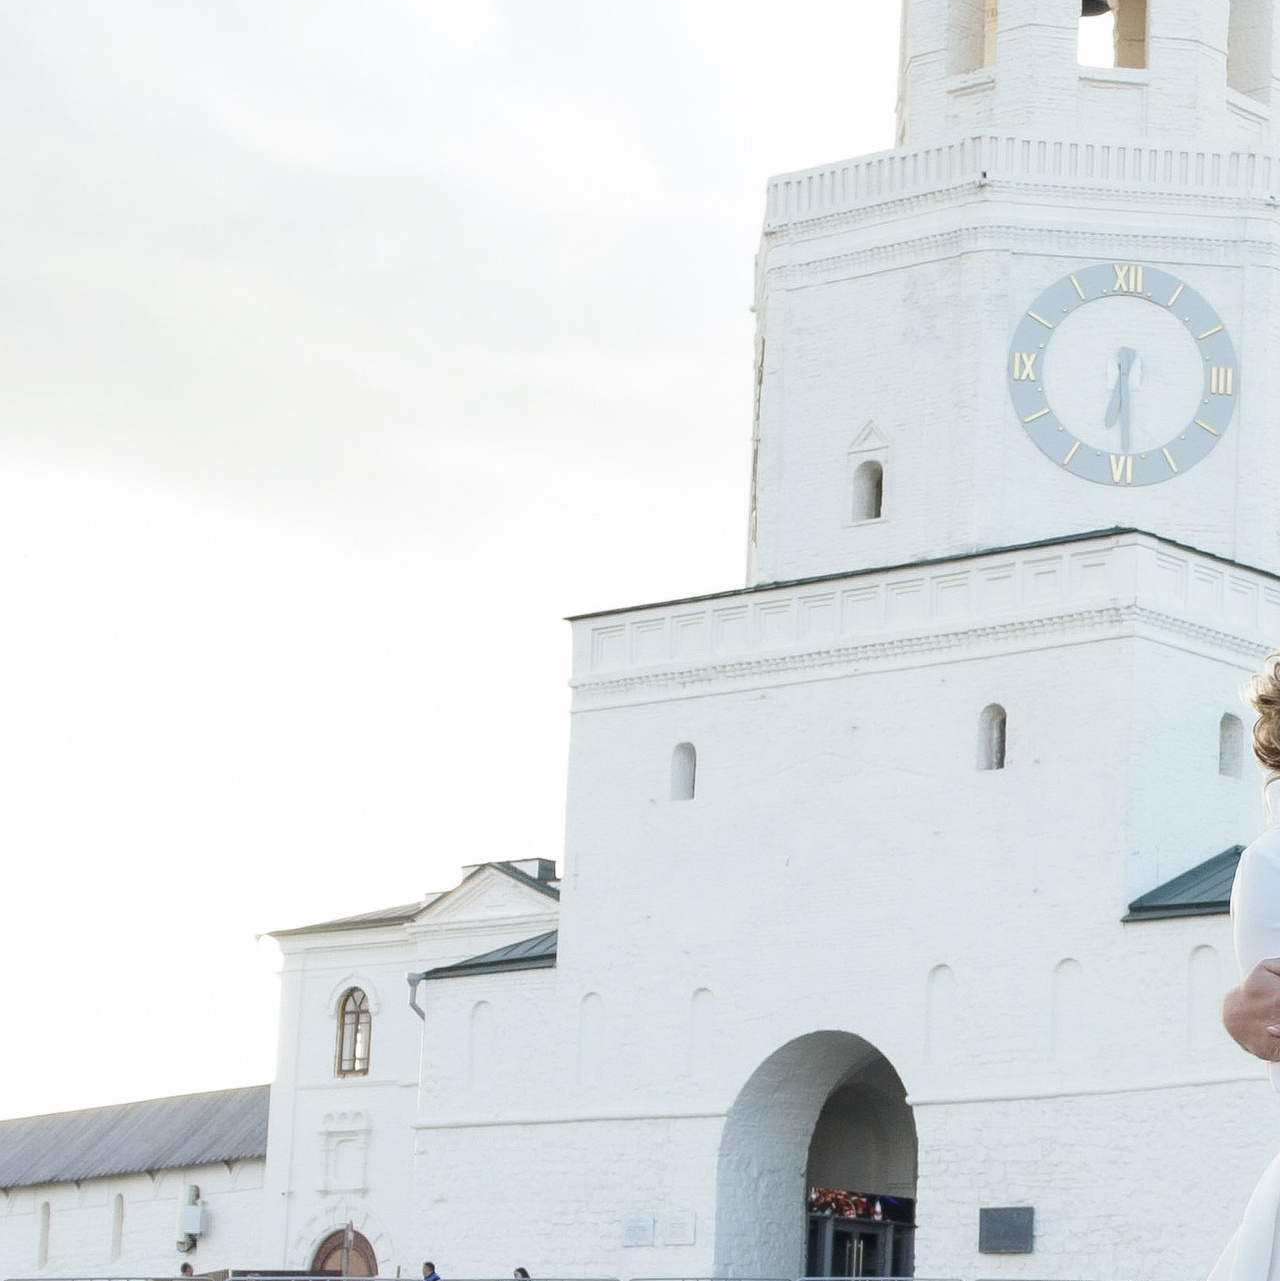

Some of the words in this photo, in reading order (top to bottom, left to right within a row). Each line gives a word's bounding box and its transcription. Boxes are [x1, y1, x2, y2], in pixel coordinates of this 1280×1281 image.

[1113, 264, 1143, 293] XII
[1012, 351, 1037, 381] IX
[1210, 366, 1233, 396] III
[1110, 453, 1133, 484] VI
